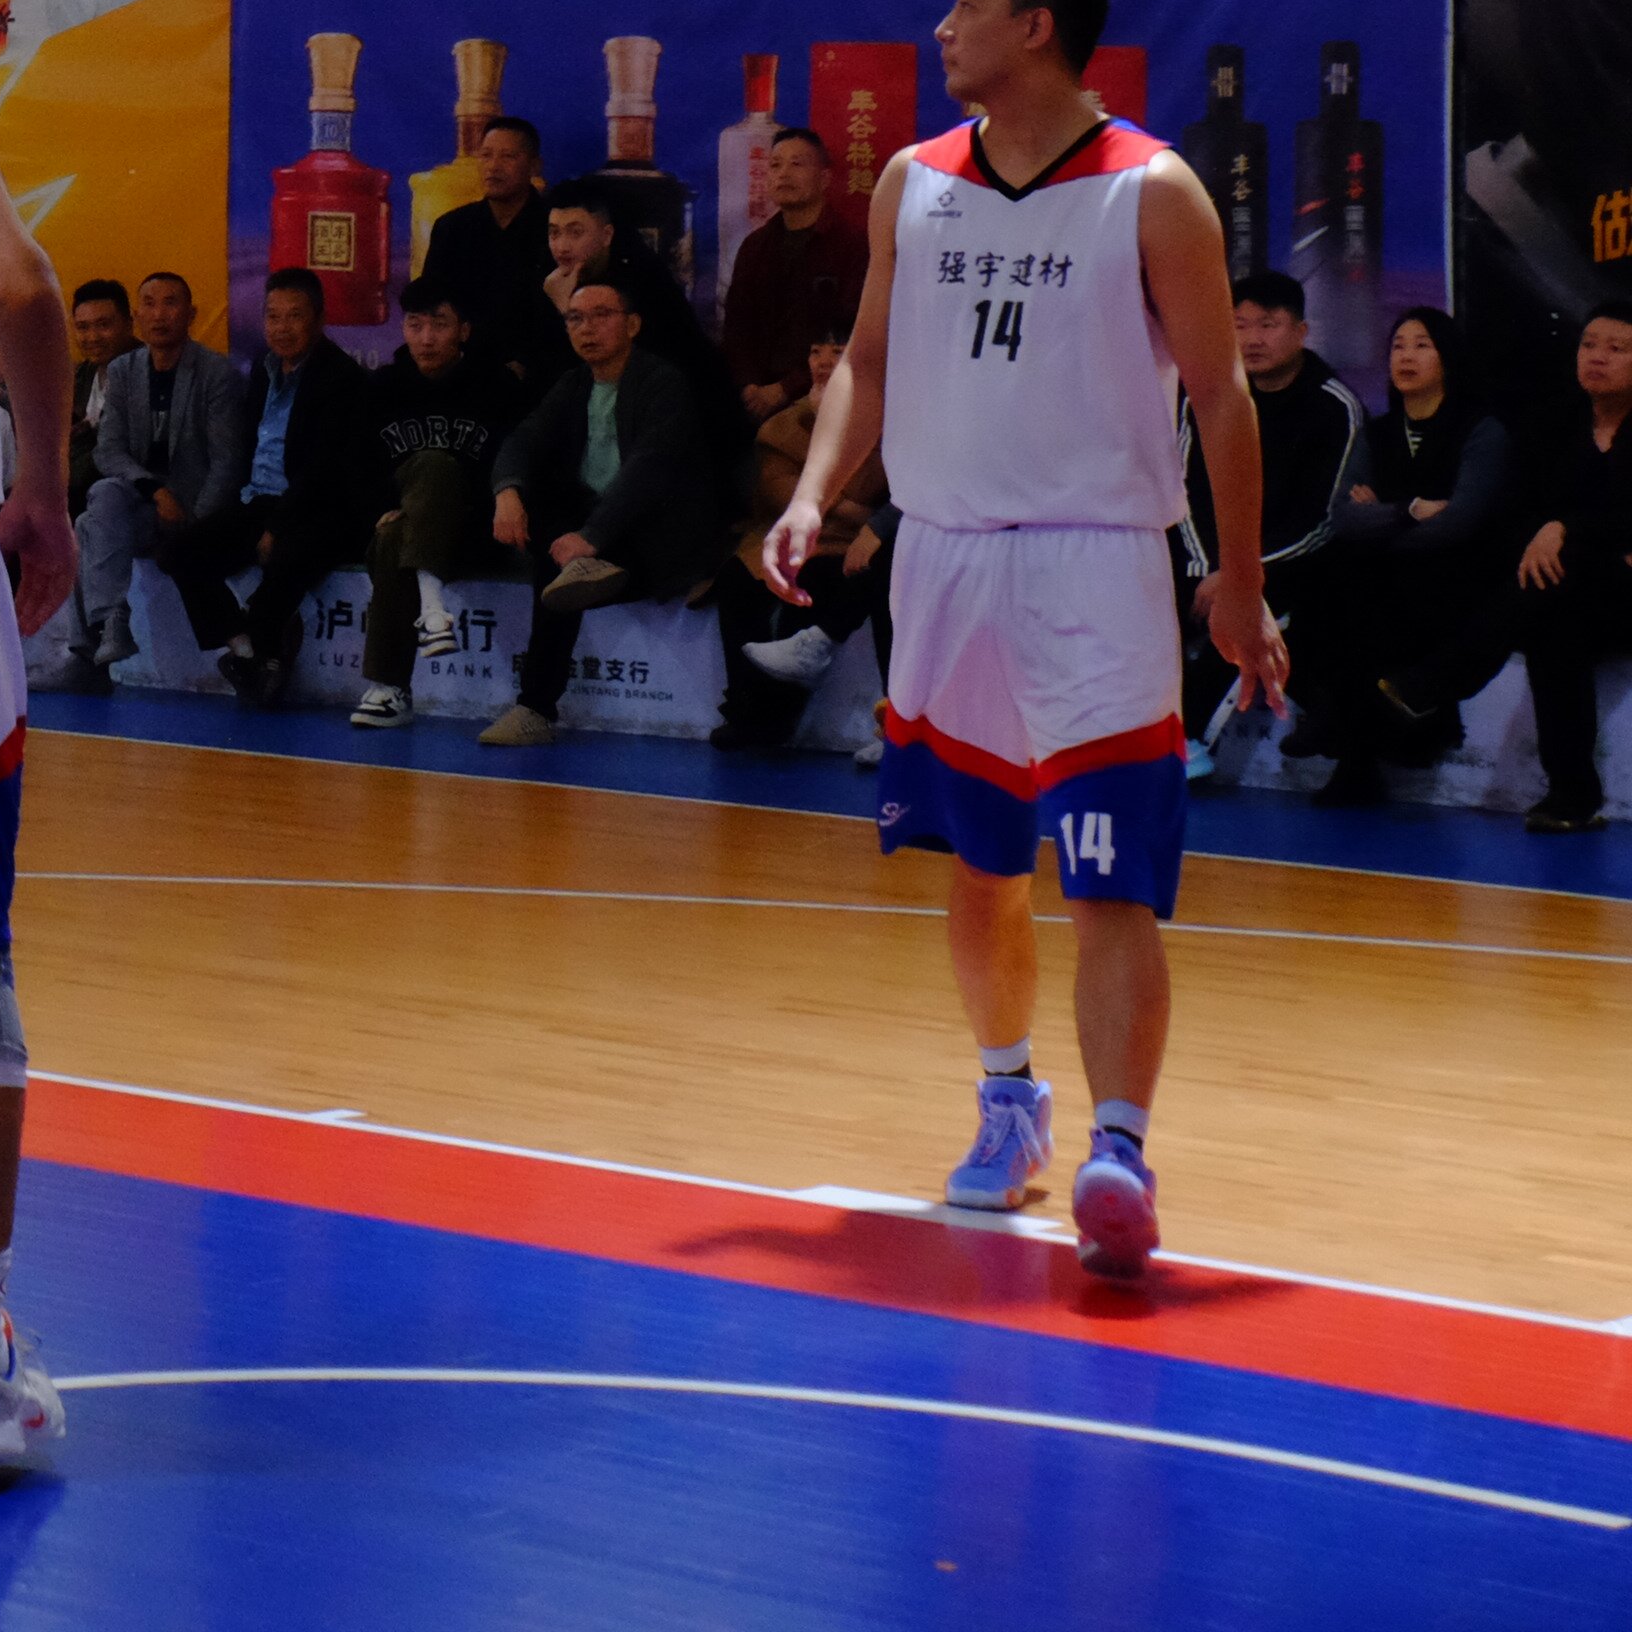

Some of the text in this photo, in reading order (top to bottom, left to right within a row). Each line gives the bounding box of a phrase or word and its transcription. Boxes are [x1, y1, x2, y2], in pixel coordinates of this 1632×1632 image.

[936, 250, 1074, 288] 强宇建材
[971, 299, 1025, 363] 14
[431, 660, 494, 680] BANK
[623, 687, 674, 702] BRANCH
[1058, 812, 1117, 878] 14
